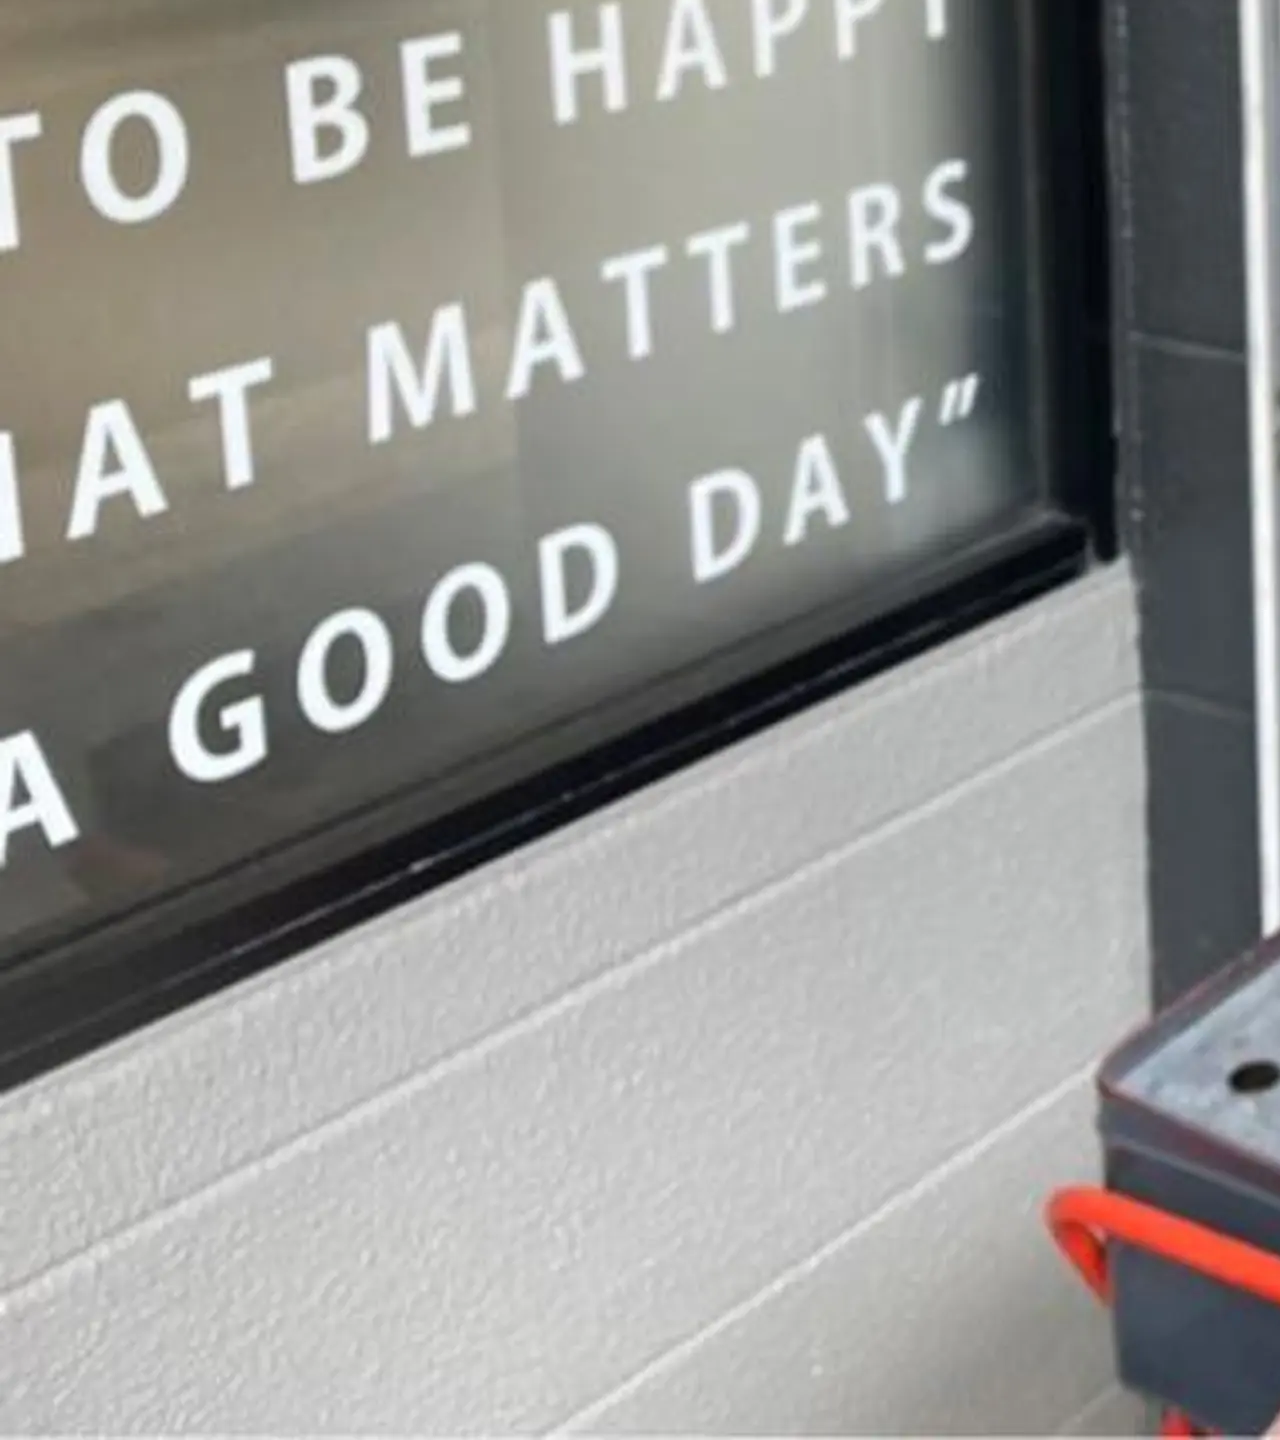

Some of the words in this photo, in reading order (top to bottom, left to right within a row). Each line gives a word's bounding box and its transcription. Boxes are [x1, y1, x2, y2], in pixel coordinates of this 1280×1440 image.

[0, 88, 190, 252] TO
[285, 32, 471, 183] BE
[366, 160, 974, 444] MATTERS
[0, 730, 79, 864] A
[168, 523, 620, 782] GOOD
